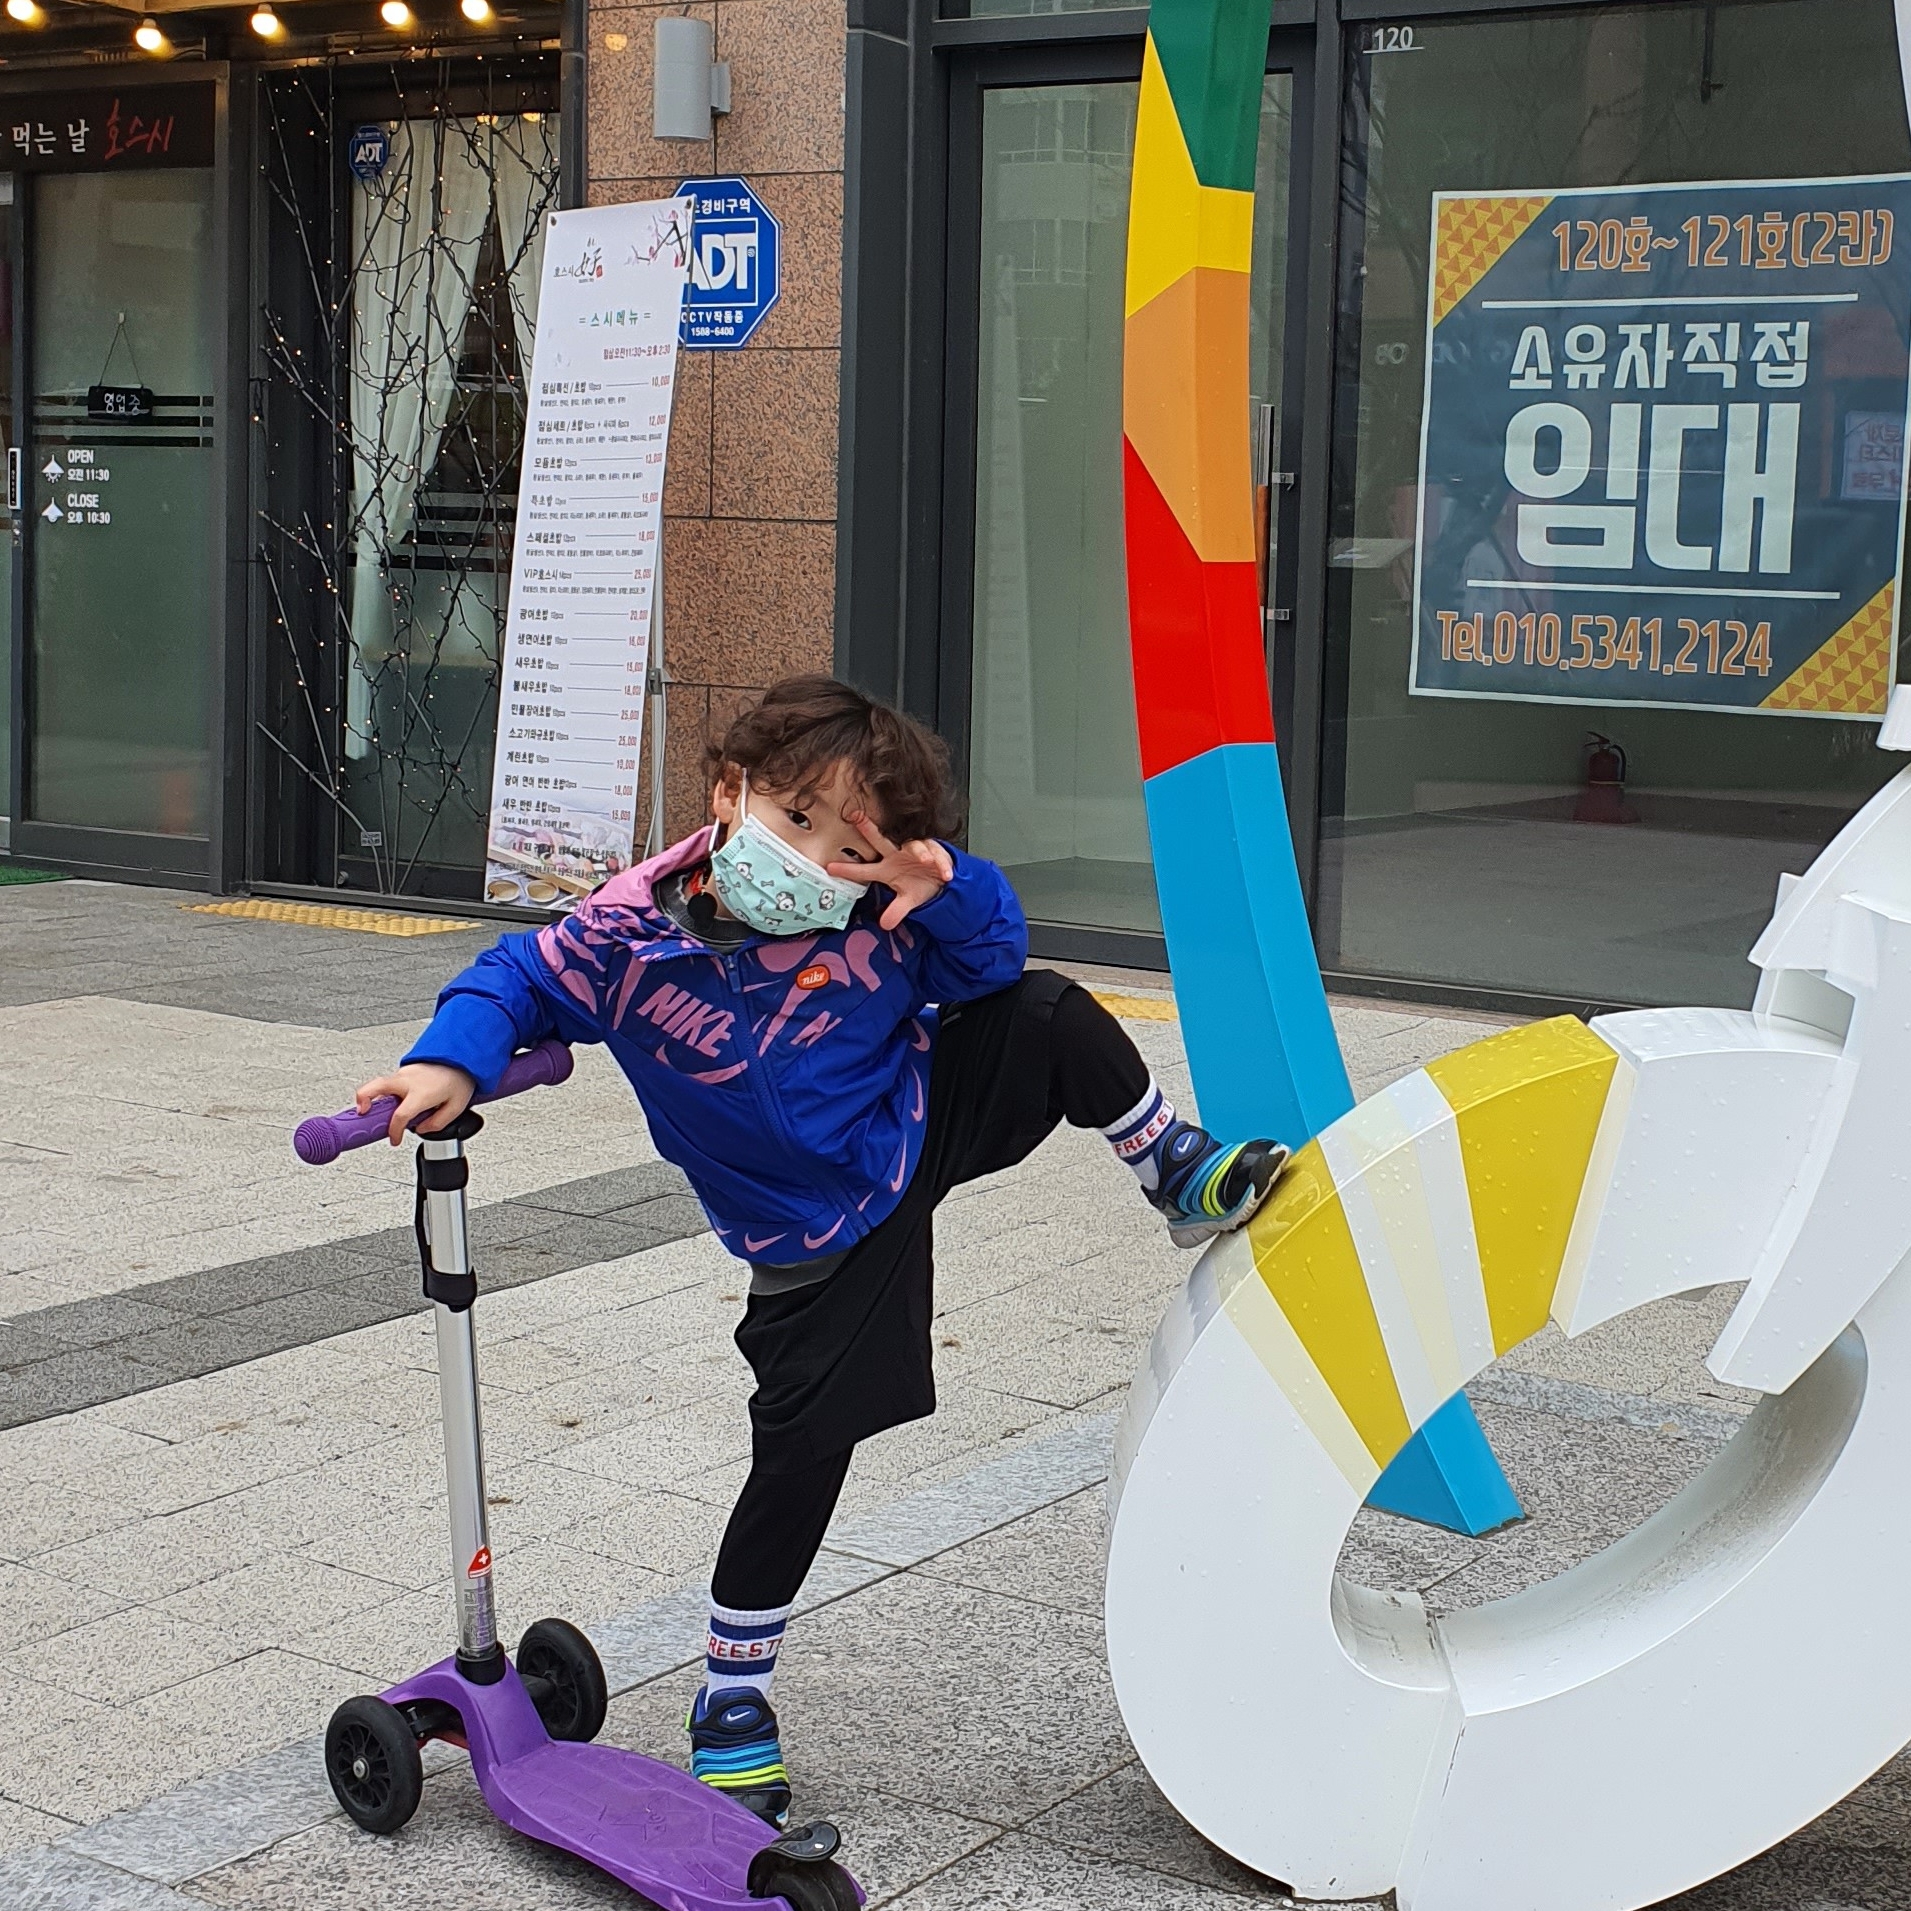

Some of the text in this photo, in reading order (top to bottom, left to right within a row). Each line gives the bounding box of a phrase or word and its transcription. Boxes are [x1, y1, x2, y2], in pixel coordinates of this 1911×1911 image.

[1374, 25, 1413, 50] 120
[12, 98, 176, 161] 먹는 날 호스시
[354, 142, 383, 163] ADT
[1552, 209, 1895, 273] 120호~121호(2칸)
[681, 310, 744, 324] CCTV작동중
[1509, 321, 1810, 391] 소유자직접
[67, 450, 94, 464] OPEN
[67, 468, 110, 482] 오전 11:30
[1503, 402, 1801, 575] 임대
[67, 494, 99, 508] CLOSE
[67, 511, 110, 524] 오후 10:30
[519, 608, 548, 621] 광어초밥
[1436, 609, 1773, 678] Tel.010.5341.2124
[515, 657, 544, 670] 새우초밥
[504, 775, 519, 787] 광어
[502, 797, 517, 810] 새우
[802, 971, 825, 985] nike
[636, 982, 736, 1058] NIKE
